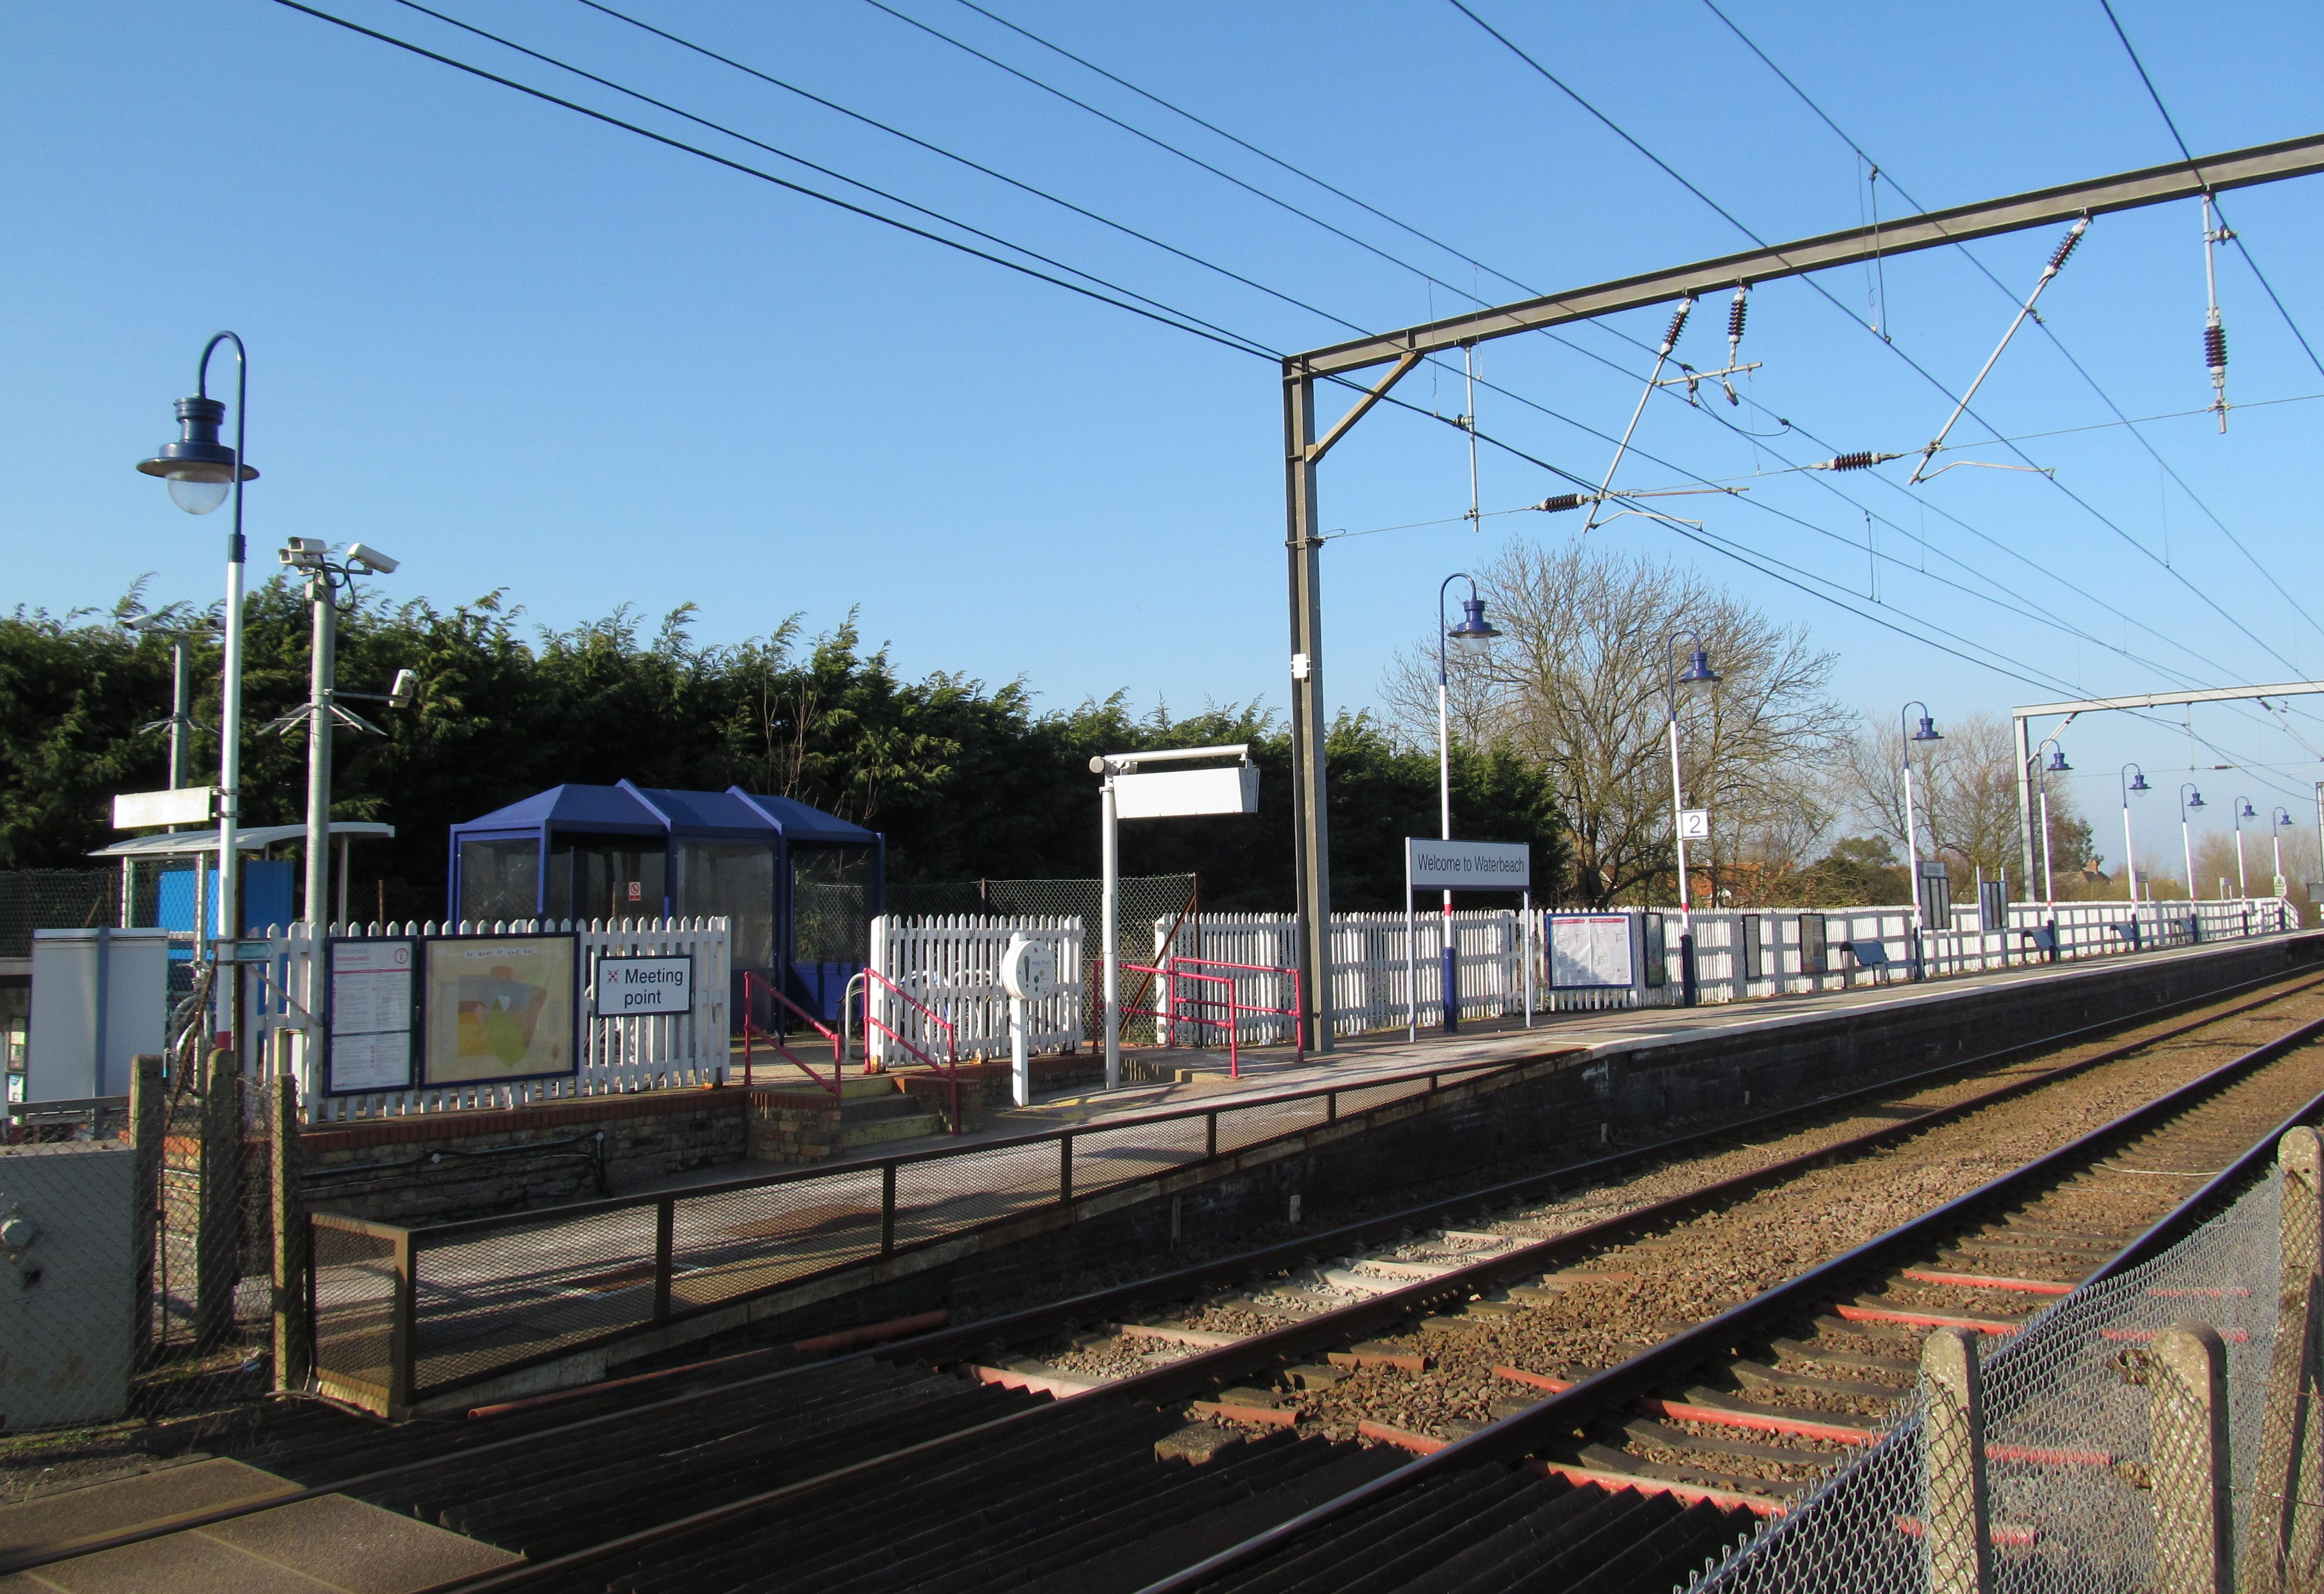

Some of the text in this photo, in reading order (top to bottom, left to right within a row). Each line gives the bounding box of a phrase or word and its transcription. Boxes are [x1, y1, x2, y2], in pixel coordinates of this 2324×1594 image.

[1689, 815, 1701, 834] 2
[1418, 854, 1524, 872] Welcome to Waterbeach
[625, 968, 683, 986] Meeting
[624, 989, 662, 1009] point
